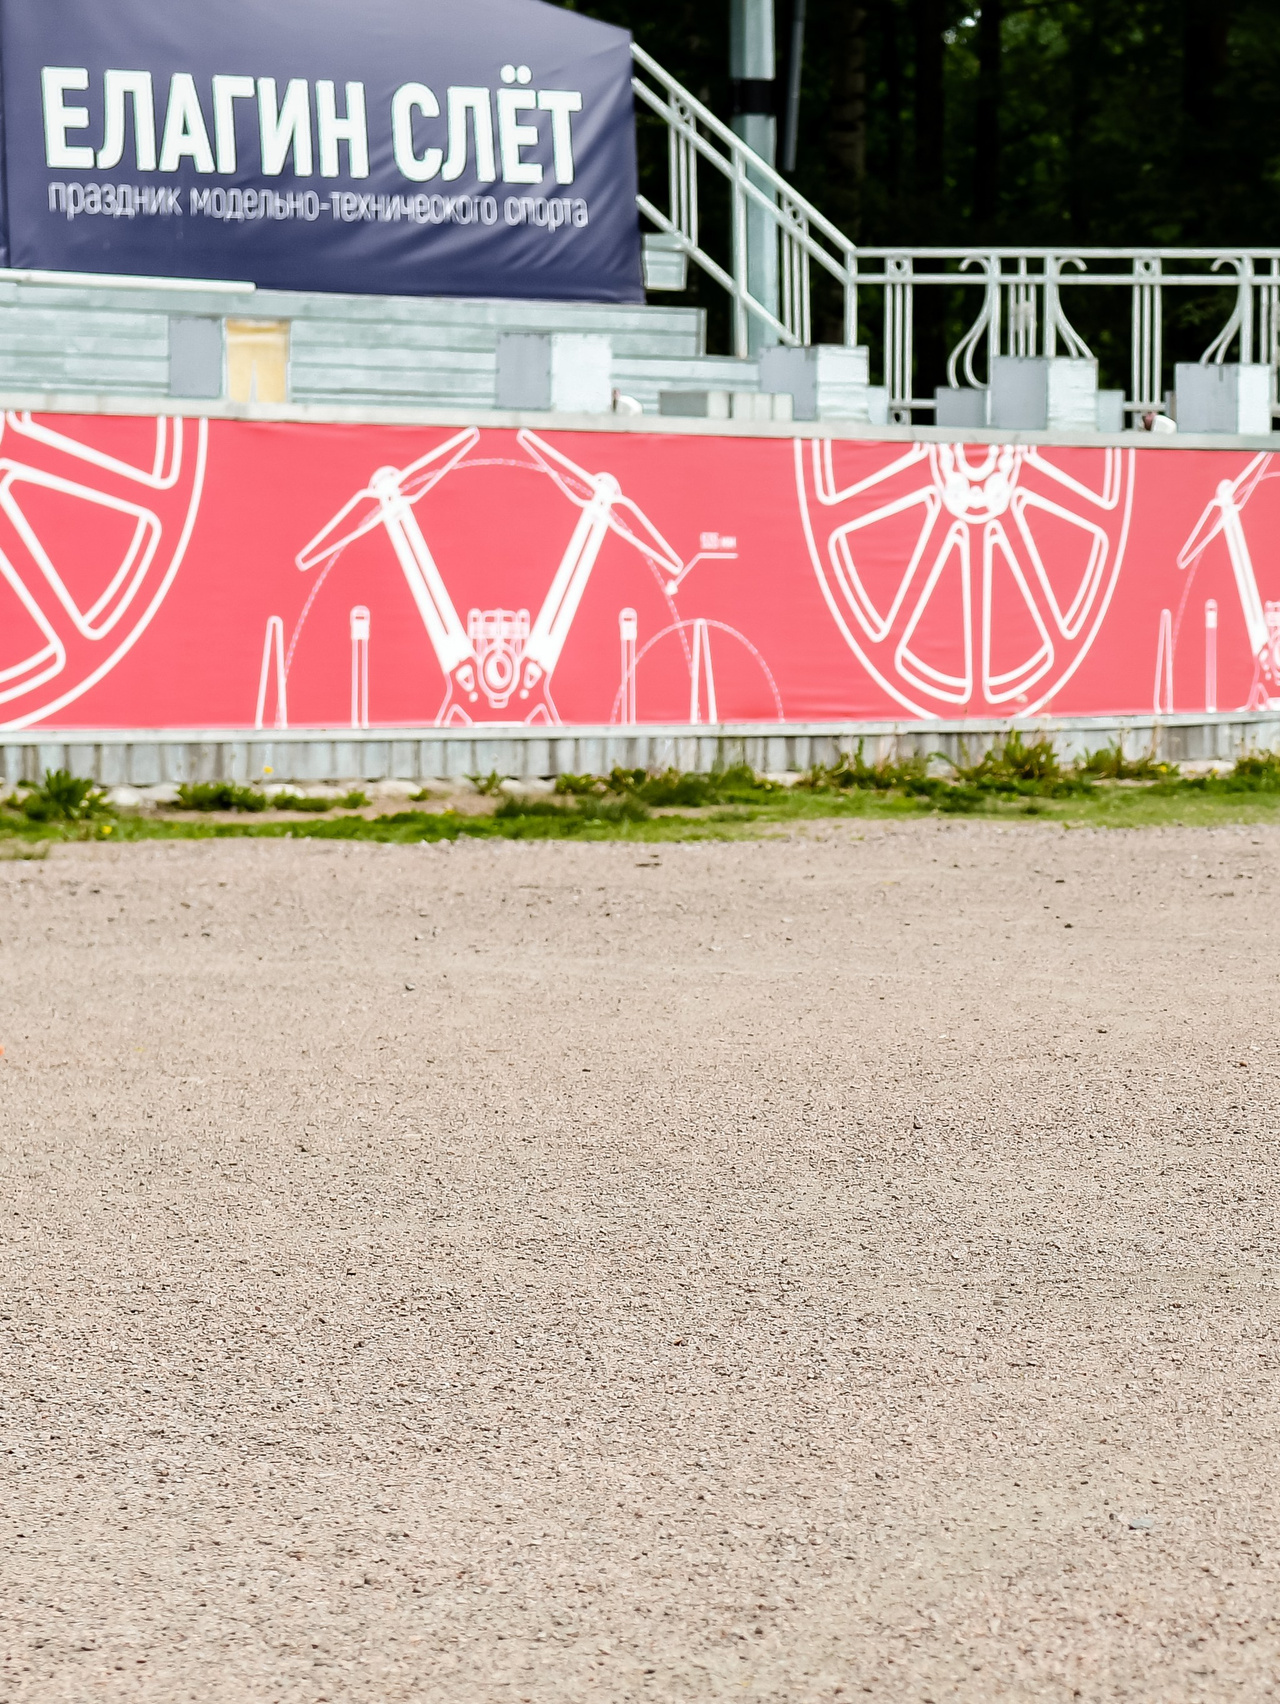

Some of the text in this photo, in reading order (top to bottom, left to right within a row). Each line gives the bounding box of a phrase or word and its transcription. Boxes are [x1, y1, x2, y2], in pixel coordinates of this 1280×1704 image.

[41, 64, 583, 185] ЕЛАГИН СЛЁТ
[48, 181, 589, 233] праздник модельно-технического спорта
